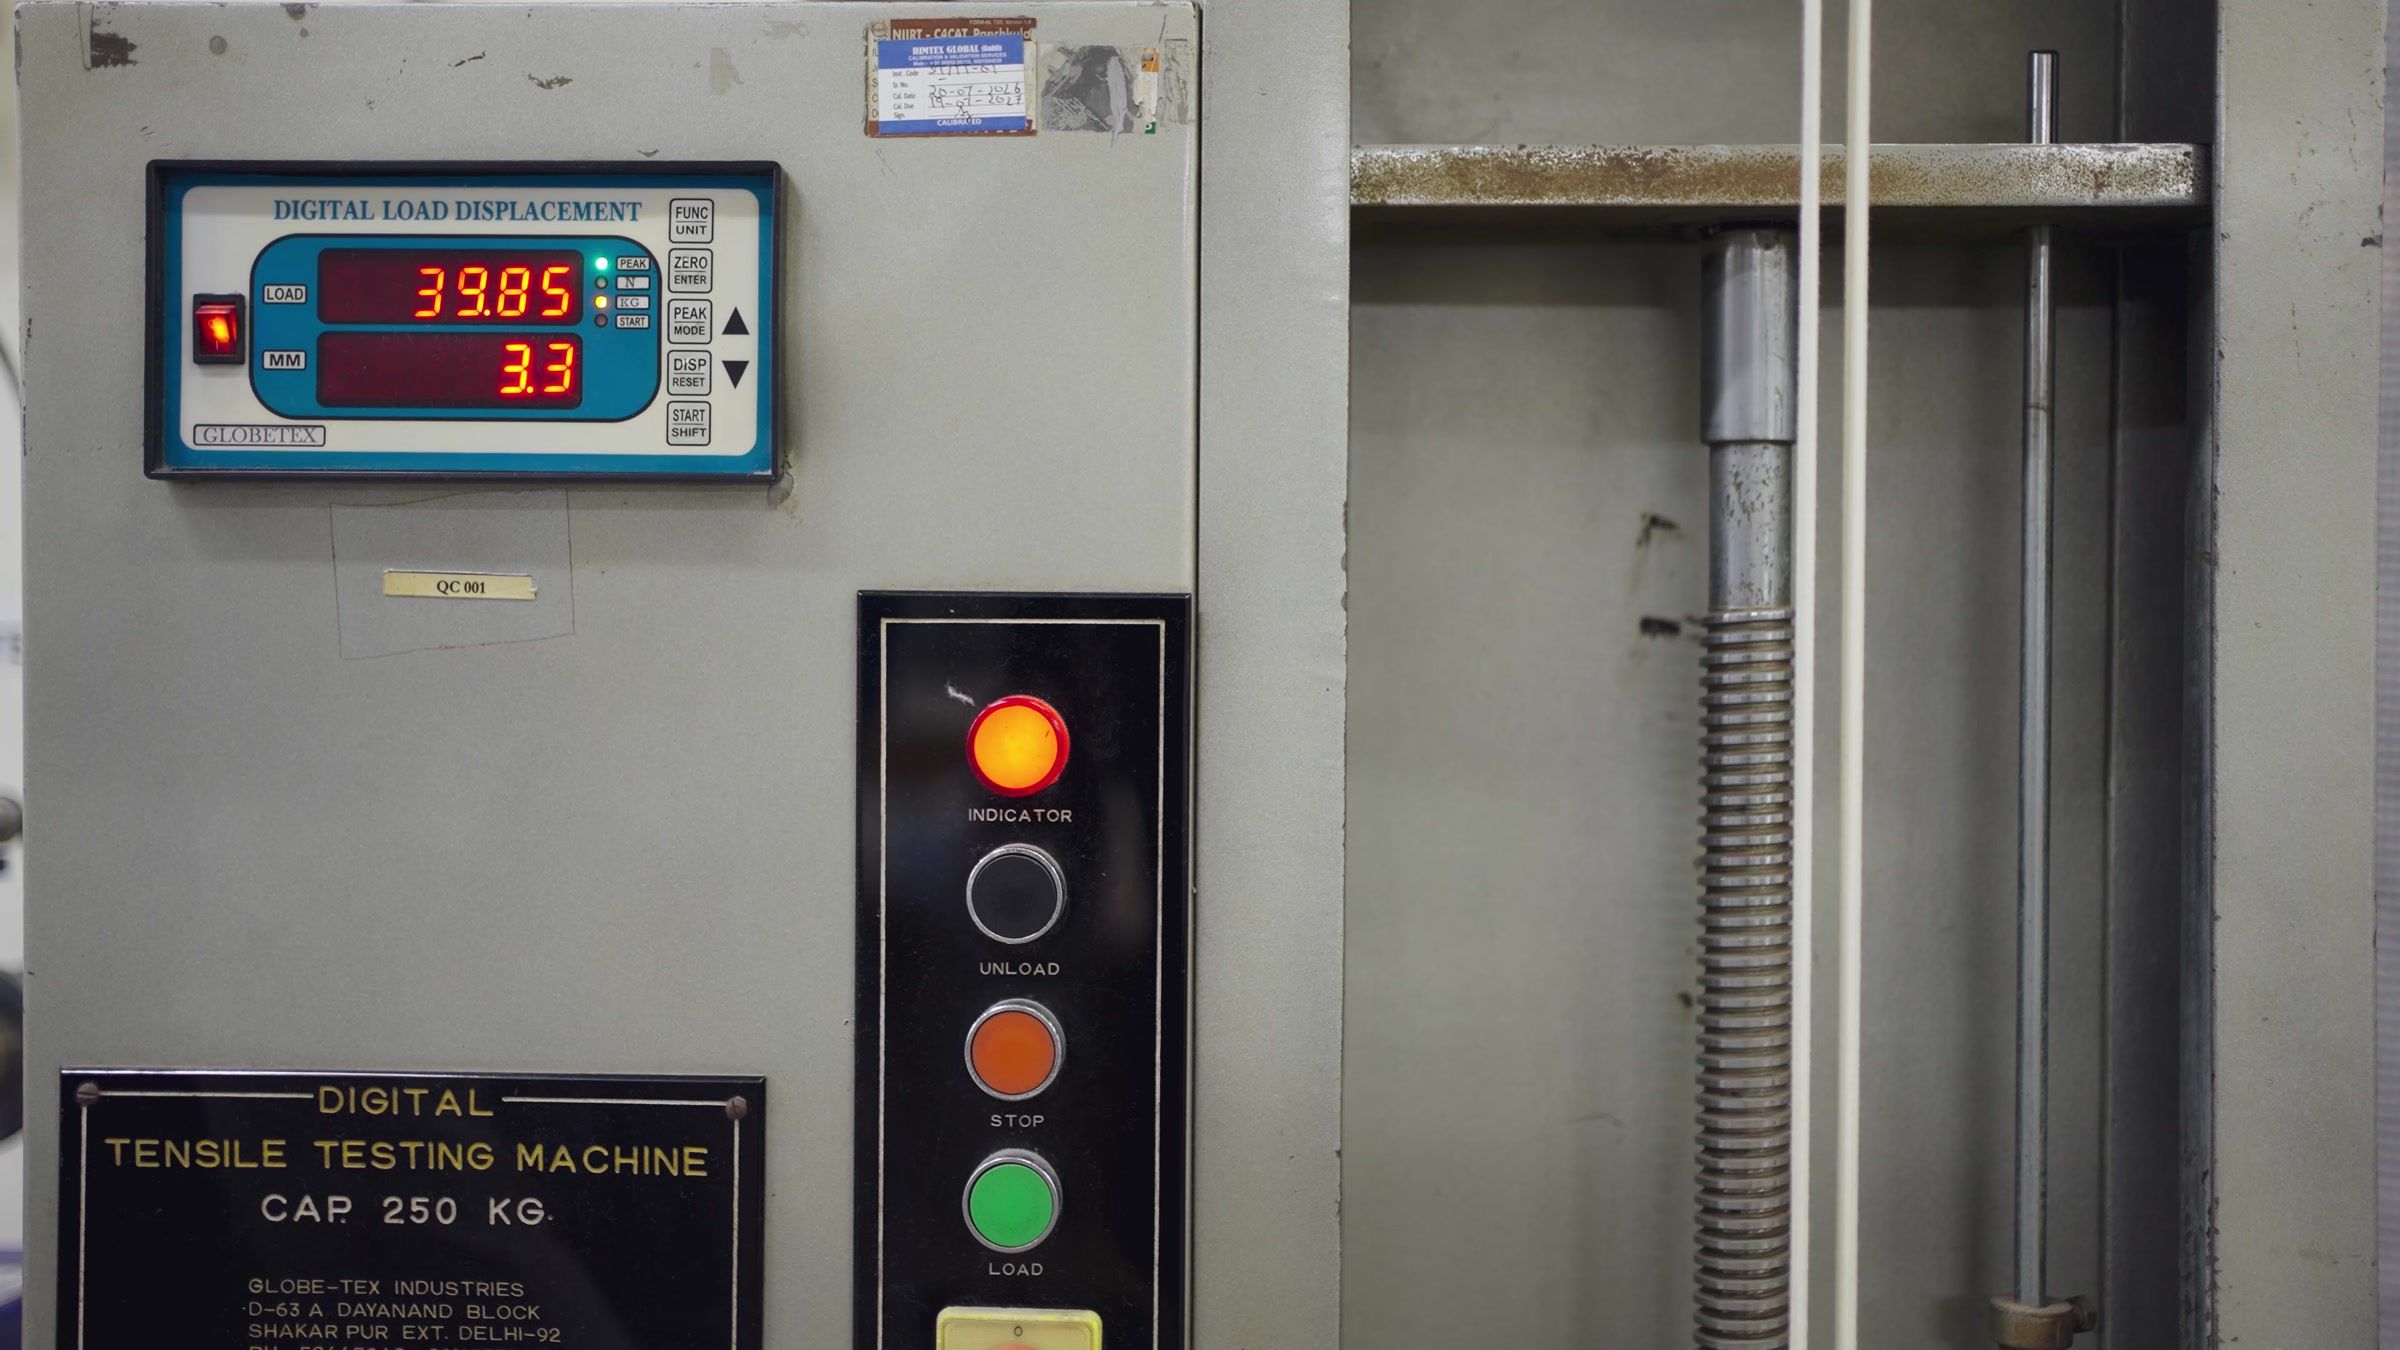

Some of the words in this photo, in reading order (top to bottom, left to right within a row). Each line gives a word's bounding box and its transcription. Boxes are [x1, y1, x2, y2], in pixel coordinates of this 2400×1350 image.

[892, 28, 923, 40] NIIRT
[934, 28, 968, 38] C4CAT
[912, 46, 944, 55] HIMTEX
[946, 44, 980, 54] GLOBAL
[273, 199, 375, 220] DIGITAL
[382, 200, 449, 221] LOAD
[455, 200, 643, 222] DISPLACEMENT
[675, 206, 709, 219] FUNC
[675, 225, 708, 235] UNIT
[619, 259, 647, 269] PEAK
[674, 256, 708, 270] ZERO
[625, 277, 636, 288] N
[674, 274, 707, 285] ENTER
[266, 287, 304, 301] LOAD
[414, 265, 571, 318] 39.85
[620, 298, 640, 307] KG
[674, 306, 707, 320] PEAK
[620, 317, 646, 326] START
[674, 325, 705, 335] MODE
[269, 353, 301, 367] MM
[673, 358, 707, 371] DISP
[500, 342, 574, 395] 3.3
[672, 377, 705, 387] RESET
[672, 408, 706, 422] START
[203, 426, 318, 444] GLOBETEX
[671, 427, 707, 438] SHIFT
[436, 579, 461, 595] QC
[464, 581, 486, 594] 001
[968, 807, 1073, 823] INDICATOR
[979, 961, 1060, 976] UNLOAD
[318, 1085, 494, 1118] DIGITAL
[990, 1114, 1045, 1128] STOP
[105, 1137, 288, 1169] TENSILE
[313, 1140, 494, 1171] TESTING
[517, 1142, 709, 1177] MACHINE
[383, 1195, 457, 1225] 250
[488, 1197, 554, 1226] KG.
[989, 1262, 1044, 1277] LOAD
[248, 1278, 381, 1296] GLOBE-TEX
[394, 1280, 526, 1297] INDUSTRIES
[248, 1302, 300, 1317] D-63
[308, 1303, 324, 1318] A
[337, 1303, 453, 1319] DAYANAND
[466, 1305, 541, 1320] BLOCK
[248, 1323, 338, 1339] SHAKAR
[346, 1324, 389, 1339] PUR
[402, 1326, 449, 1341] EXT.
[458, 1326, 562, 1343] DELHI-92
